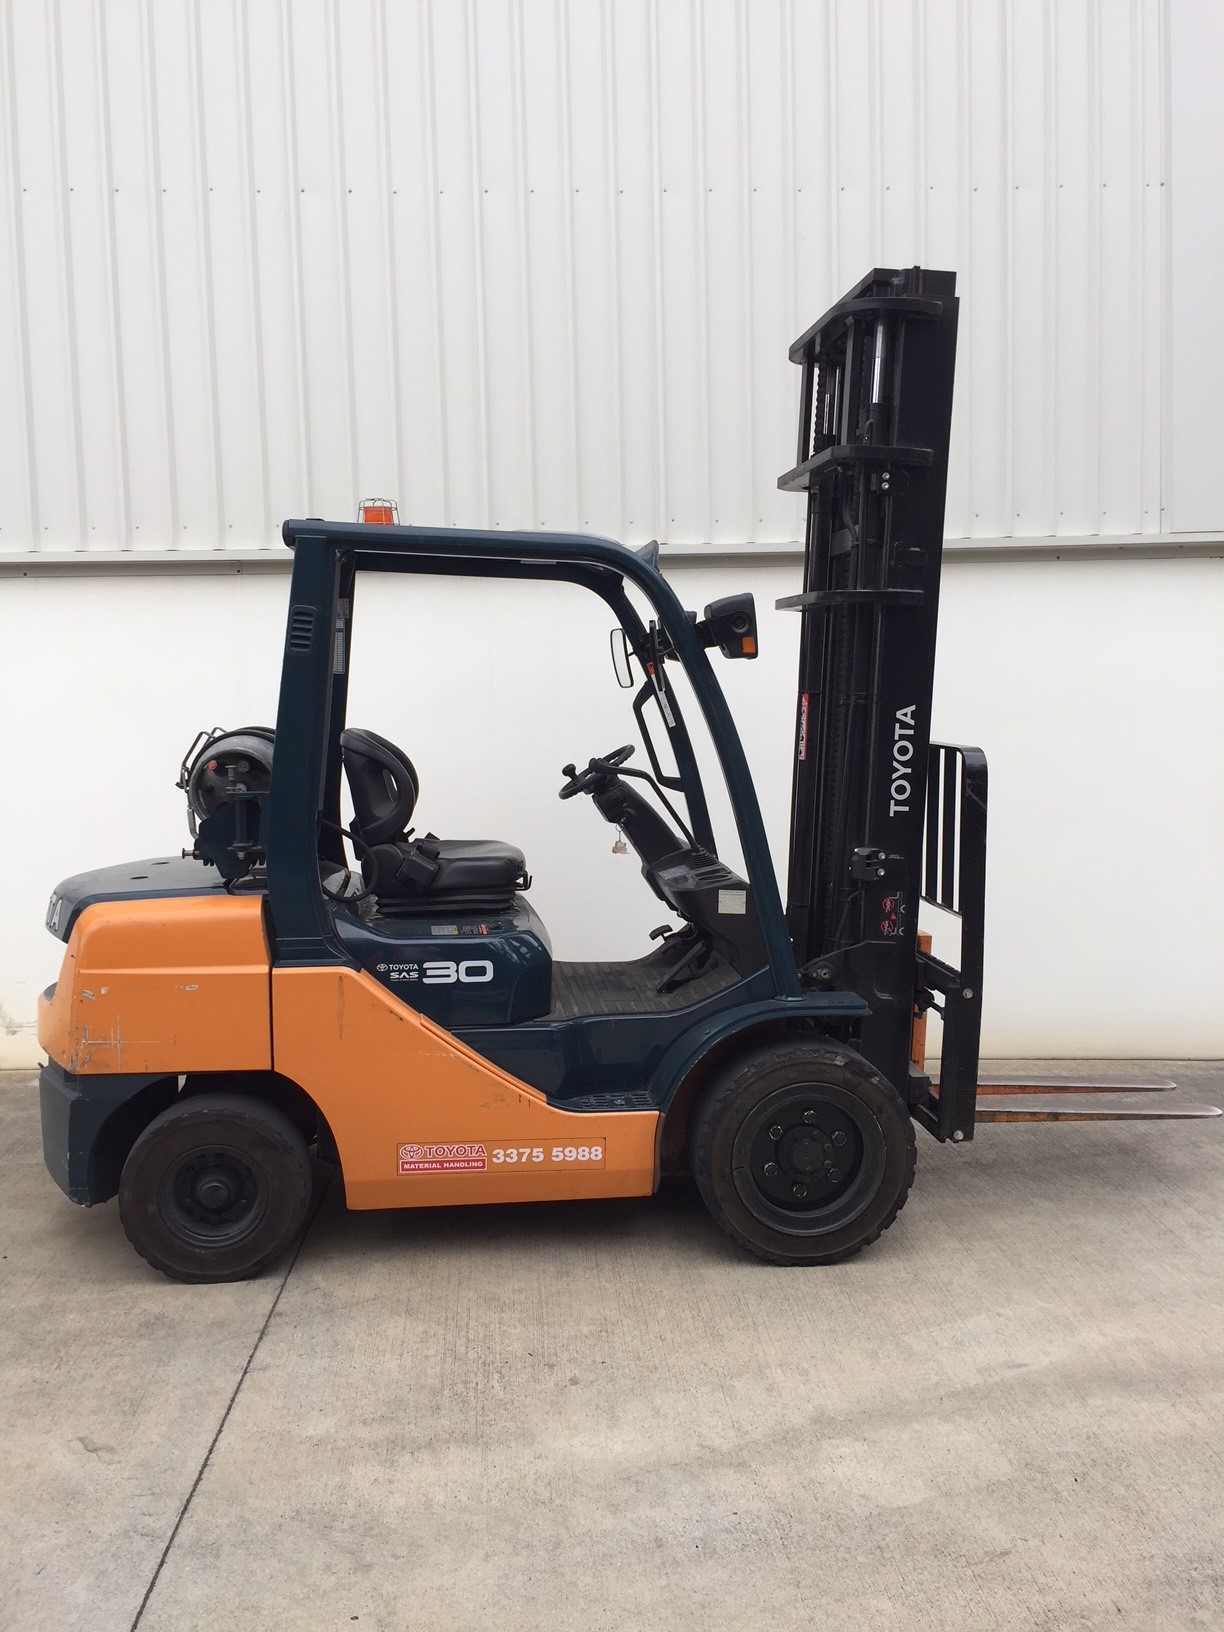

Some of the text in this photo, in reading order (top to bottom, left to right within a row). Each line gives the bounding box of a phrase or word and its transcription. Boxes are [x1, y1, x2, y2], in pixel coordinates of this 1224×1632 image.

[889, 704, 917, 817] TOYOTA
[390, 971, 419, 979] SAS
[422, 960, 494, 984] 30
[425, 1144, 487, 1158] TOYOTA
[492, 1146, 603, 1163] 3375 5988
[443, 1160, 483, 1168] HANDLING
